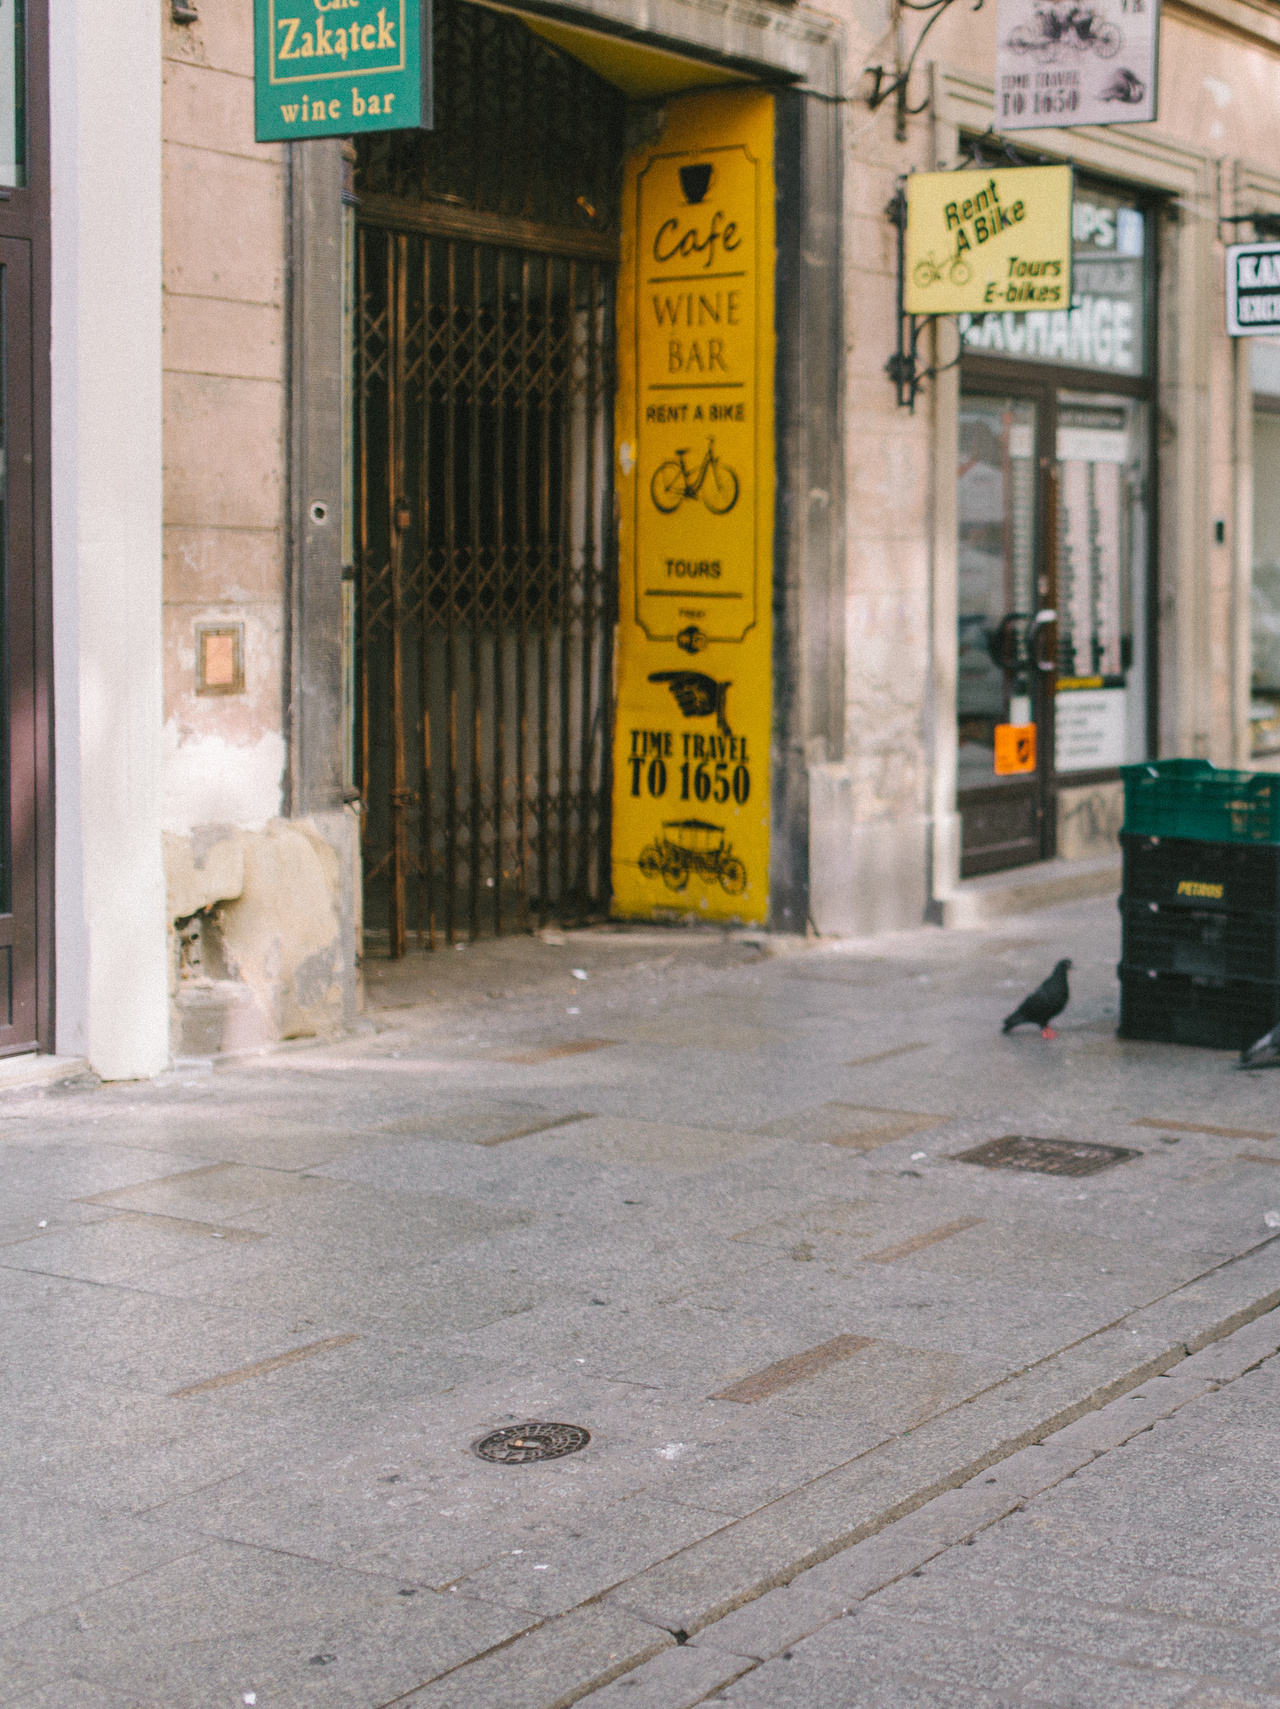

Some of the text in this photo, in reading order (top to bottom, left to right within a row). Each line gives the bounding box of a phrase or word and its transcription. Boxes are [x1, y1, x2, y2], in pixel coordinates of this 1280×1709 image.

[278, 7, 397, 60] Zakątek
[280, 87, 396, 123] wine bar
[944, 177, 999, 230] Rent
[653, 211, 742, 268] Cafe
[956, 199, 1026, 257] A Bike
[1007, 257, 1062, 277] Tours
[652, 290, 741, 328] WINE
[984, 283, 1062, 303] E-bikes
[668, 338, 728, 373] BAR
[646, 404, 746, 423] RENT A BIKE
[666, 559, 722, 579] TOURS
[630, 730, 749, 761] TIME TRAVEL
[628, 757, 750, 804] TO 1650
